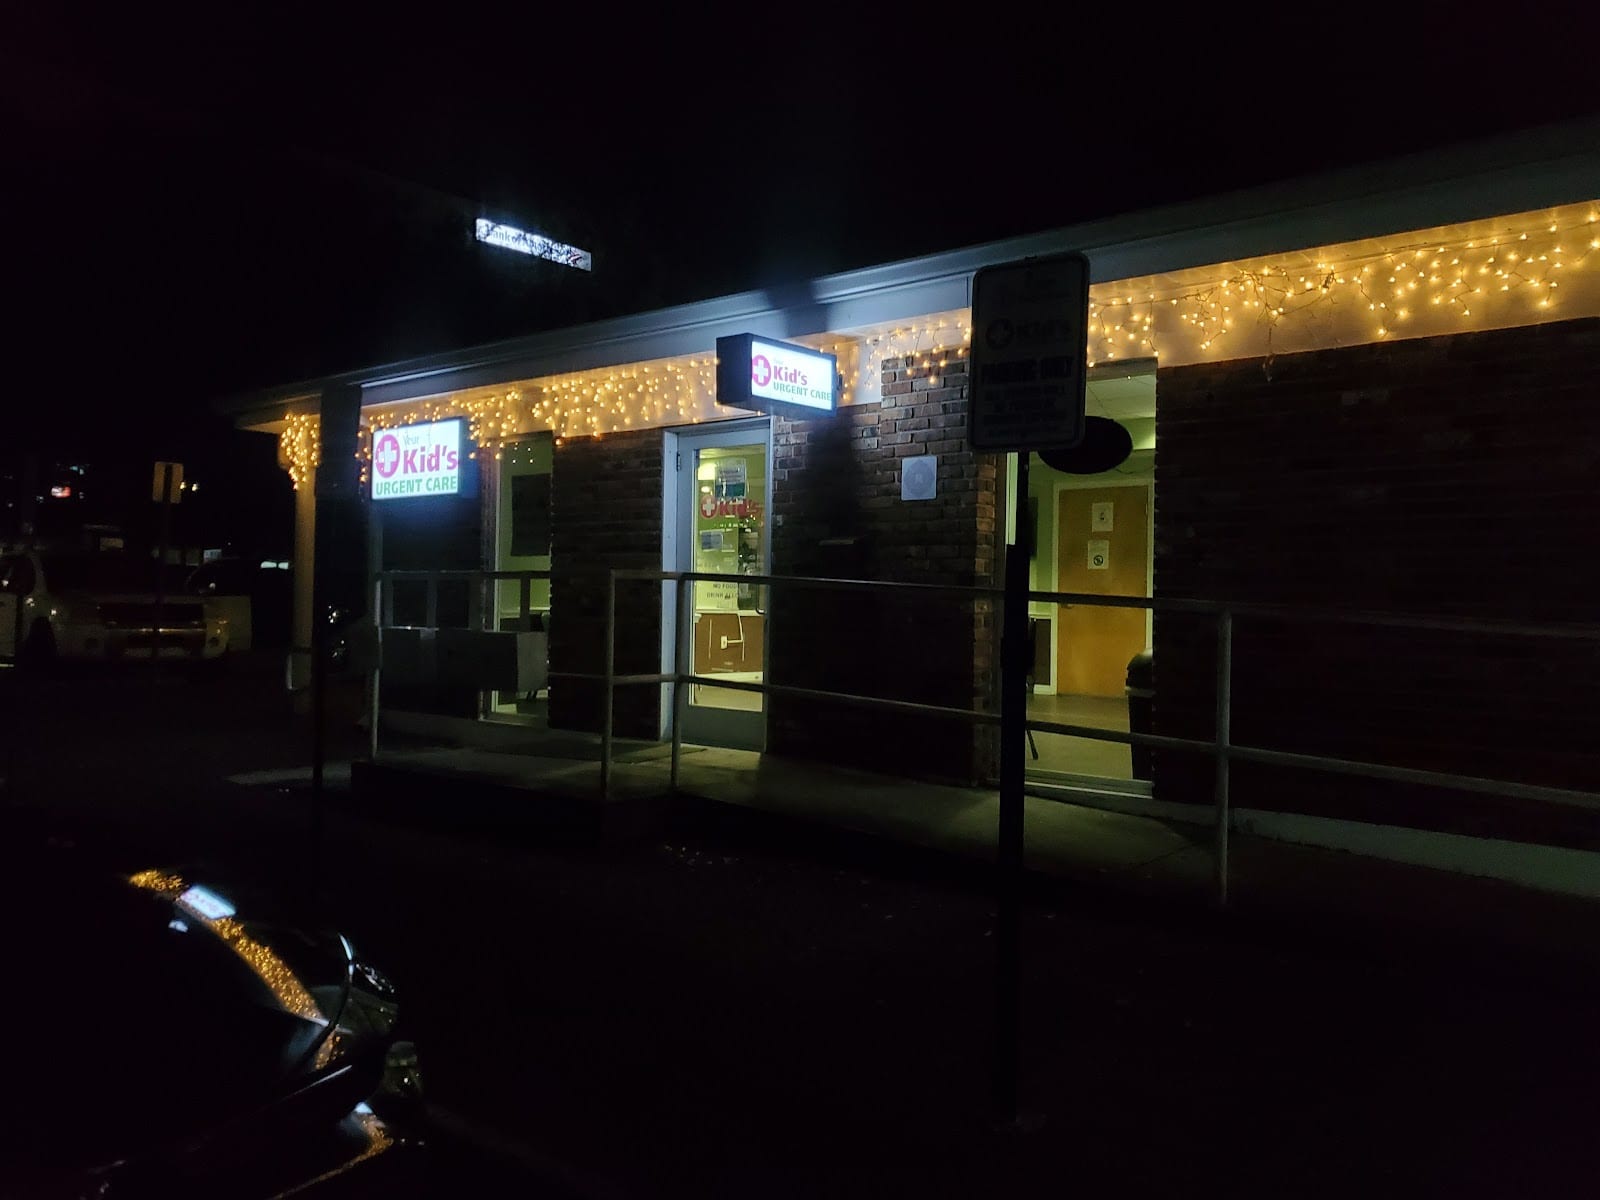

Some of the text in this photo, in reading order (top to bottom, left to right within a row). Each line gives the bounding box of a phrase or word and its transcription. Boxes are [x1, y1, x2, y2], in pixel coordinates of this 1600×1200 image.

[773, 365, 808, 386] Kid's
[773, 381, 831, 401] URGENT CARE
[403, 443, 458, 474] Kid's
[375, 476, 457, 496] URGENT CARE
